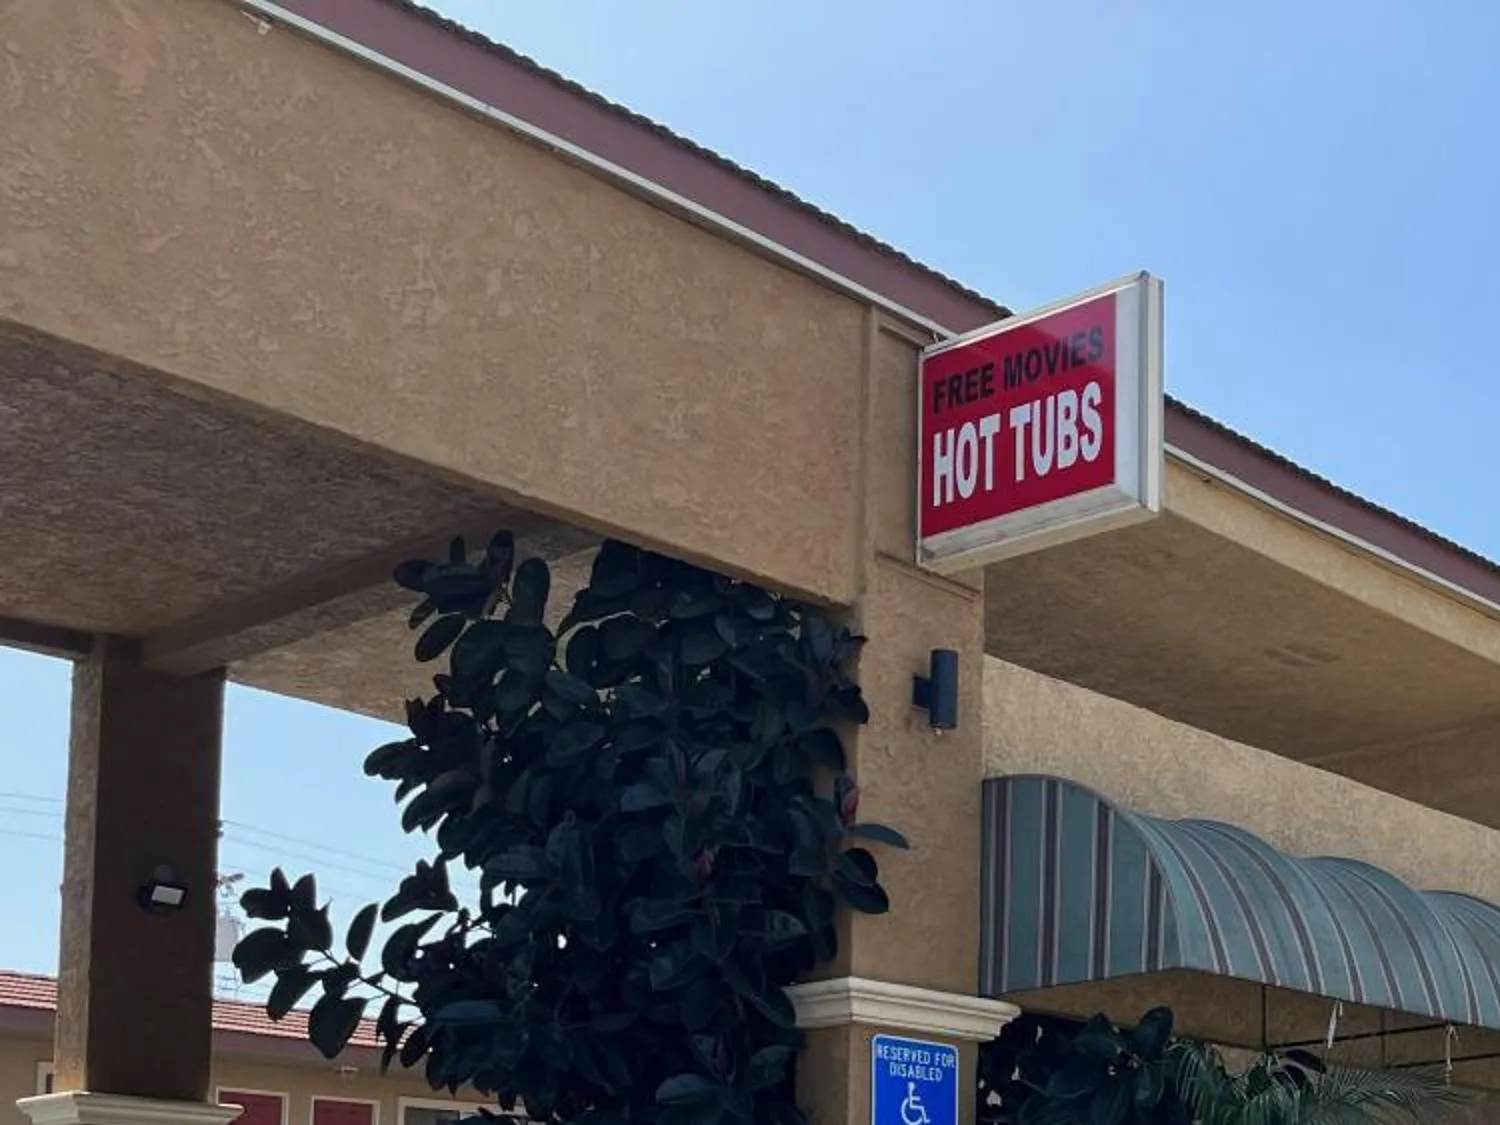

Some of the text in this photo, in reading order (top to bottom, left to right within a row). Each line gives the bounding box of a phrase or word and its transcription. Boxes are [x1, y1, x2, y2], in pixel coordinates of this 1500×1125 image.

[932, 326, 1104, 414] FREE MOVIES
[932, 381, 1103, 507] HOT TUBS
[878, 1045, 955, 1068] RESERVED FOR
[889, 1061, 943, 1082] DISABLED
